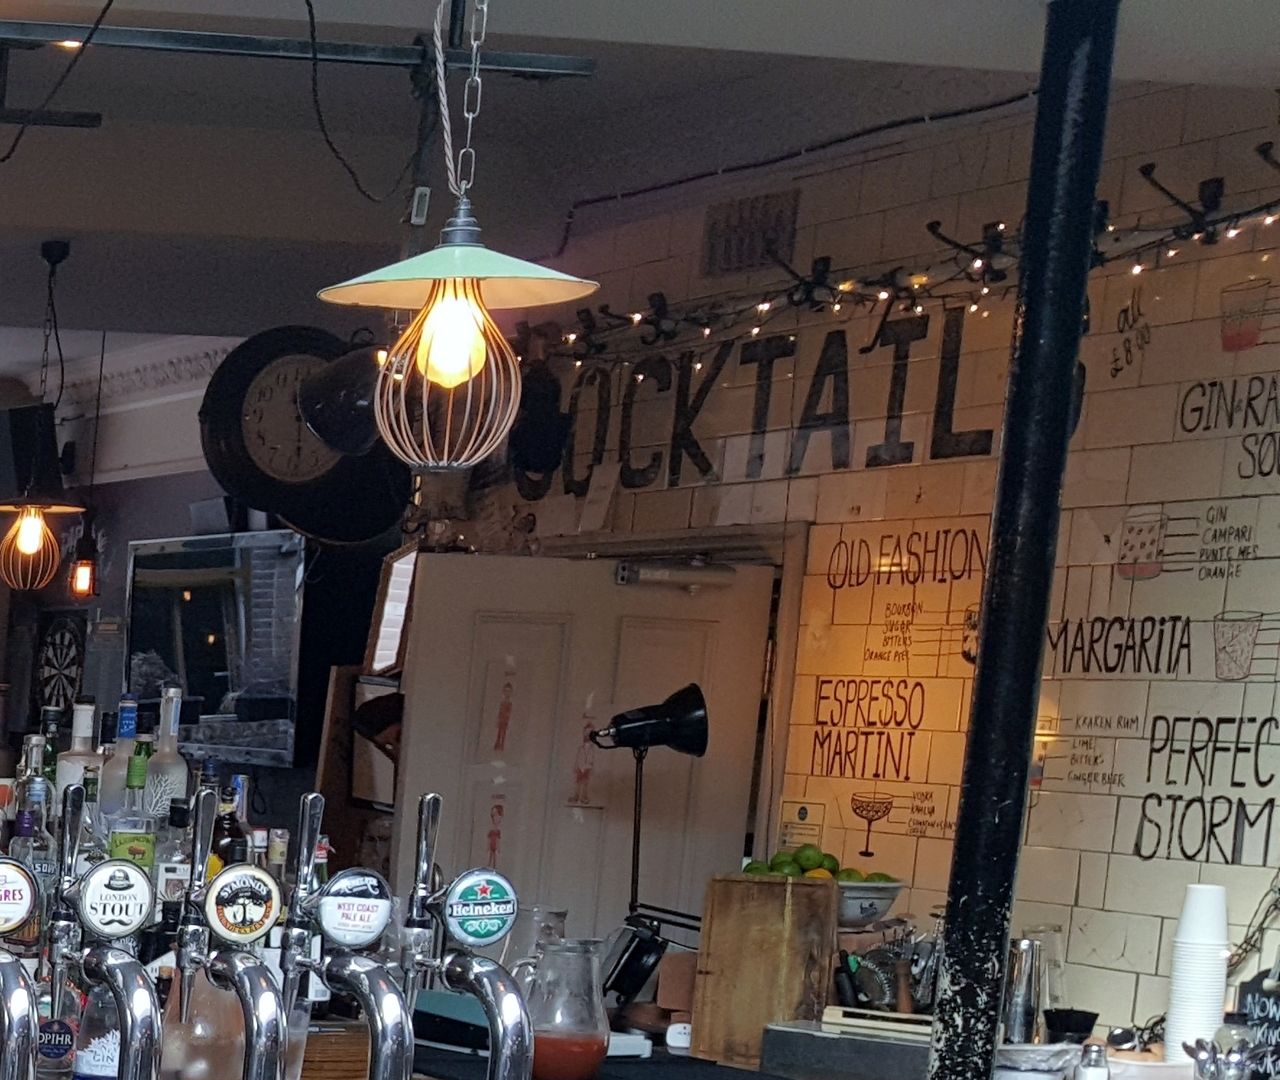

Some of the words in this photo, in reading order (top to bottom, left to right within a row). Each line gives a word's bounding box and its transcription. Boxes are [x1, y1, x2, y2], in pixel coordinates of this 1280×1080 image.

[512, 303, 1086, 501] OCKTAIL
[1206, 505, 1228, 525] GIN
[1202, 525, 1252, 545] CAMPARI
[827, 540, 872, 590] OLD
[1198, 562, 1242, 581] ORANGE
[816, 679, 926, 729] ESPRESSO
[1075, 714, 1113, 730] KRAKEN
[1116, 714, 1140, 732] RUM
[811, 730, 916, 781] MARTINI
[1133, 792, 1276, 868] STORM
[99, 893, 138, 902] LONDON
[219, 878, 269, 899] SYMONDS
[88, 902, 147, 917] STOUT
[336, 902, 355, 911] WEST
[356, 903, 380, 913] COAST
[341, 912, 357, 921] PALE
[359, 913, 372, 922] ALE
[452, 901, 515, 917] Heineken
[38, 1032, 73, 1046] OPIHR
